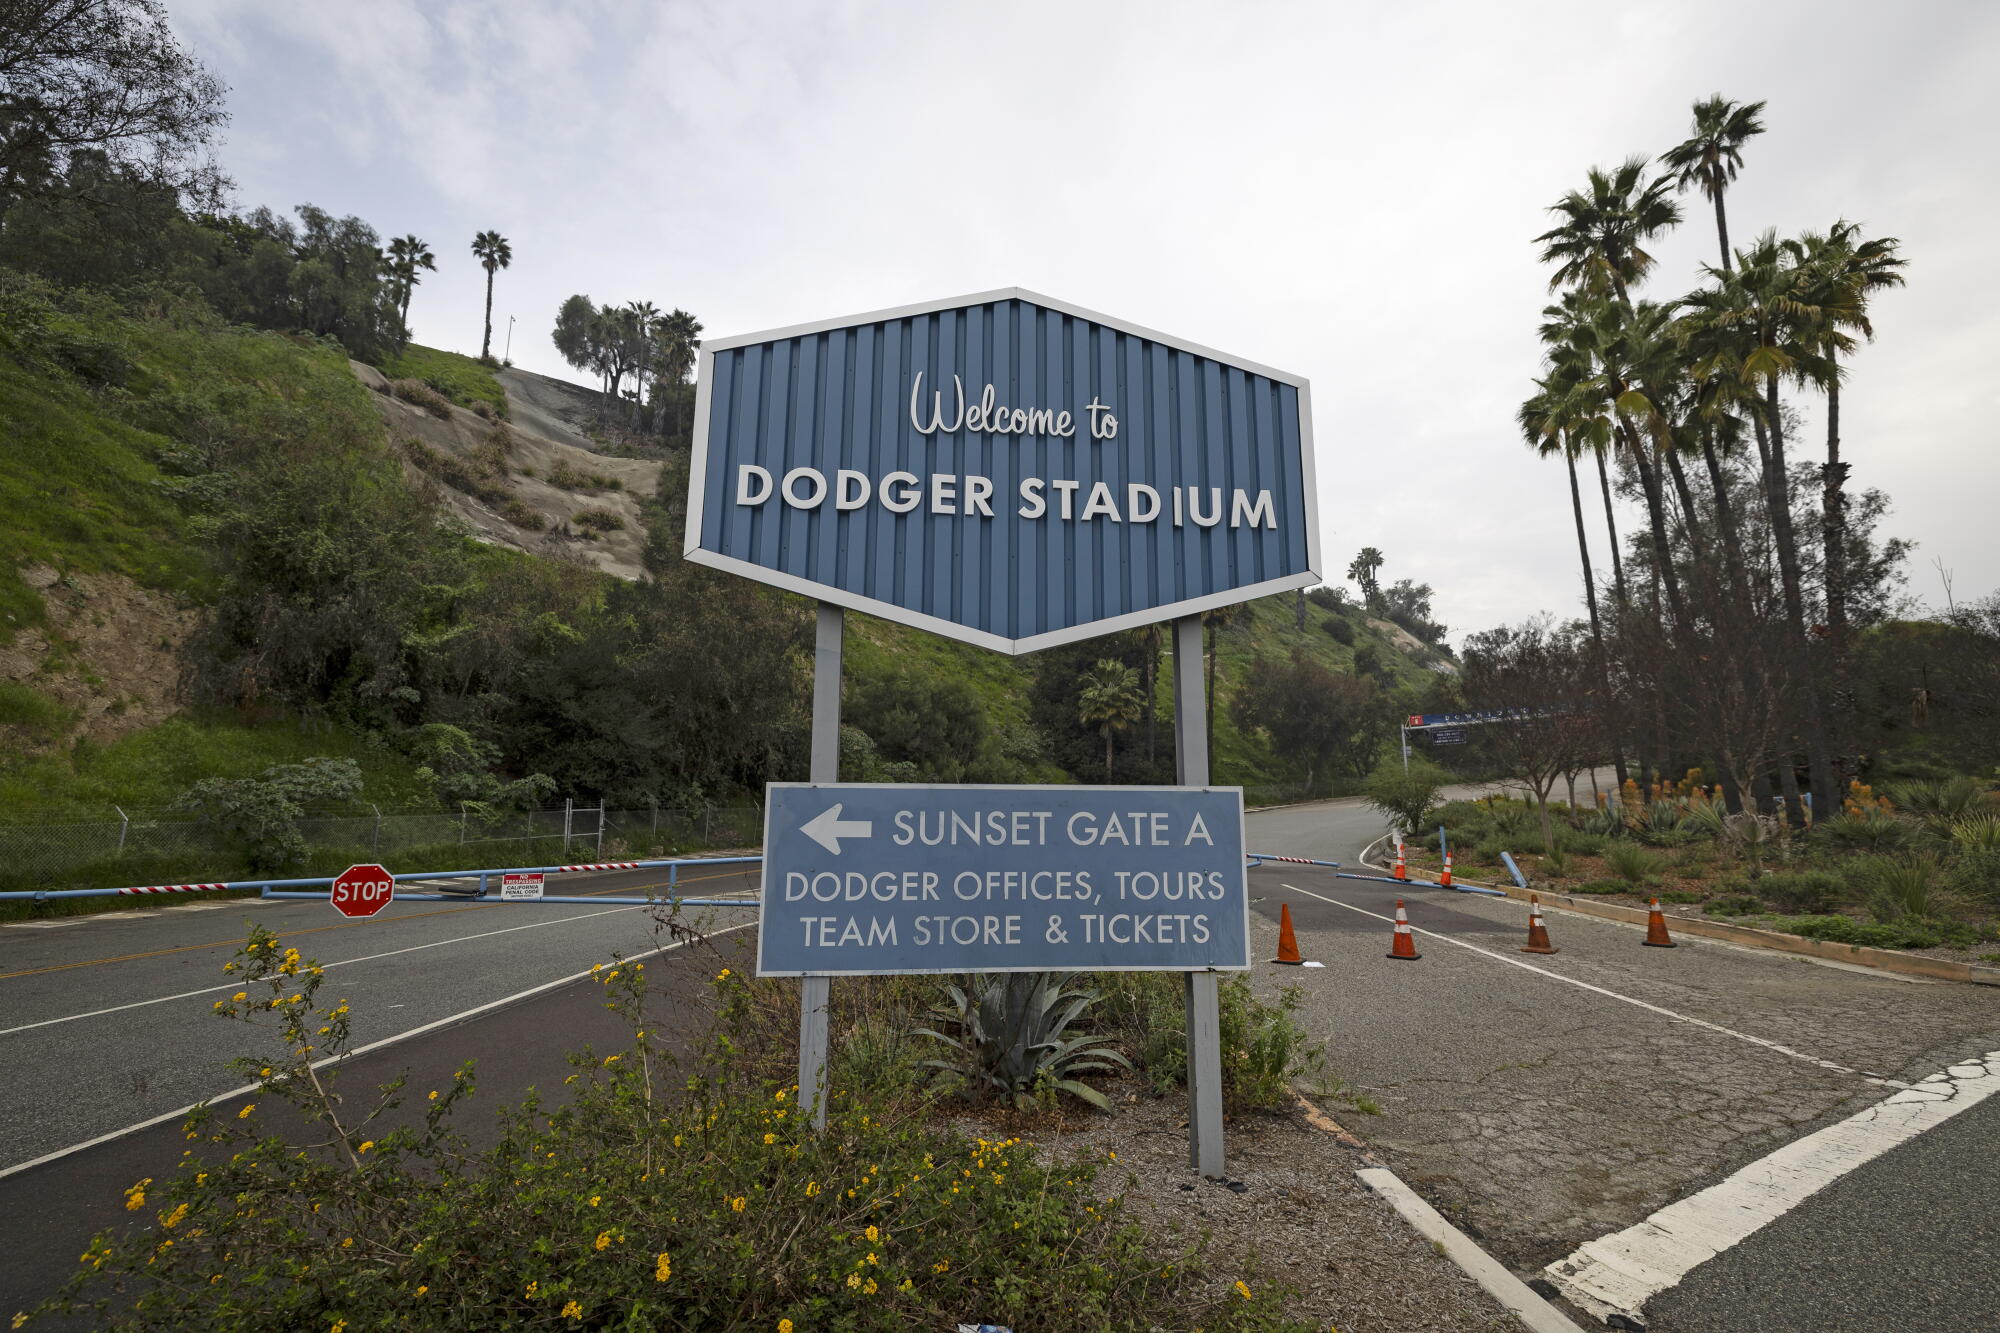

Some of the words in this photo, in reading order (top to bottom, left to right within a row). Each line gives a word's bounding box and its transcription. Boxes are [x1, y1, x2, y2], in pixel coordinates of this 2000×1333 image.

[910, 371, 1076, 437] Welcome
[1085, 396, 1119, 439] to
[736, 464, 995, 517] DODGER
[1018, 477, 1277, 529] STADIUM
[892, 810, 1052, 846] SUNSET
[1066, 811, 1170, 846] GATE
[1184, 812, 1214, 846] A
[336, 881, 389, 902] STOP
[785, 871, 940, 902] DODGER
[953, 871, 1102, 906] OFFICES,
[1114, 871, 1225, 901] TOURS
[799, 915, 898, 948] TEAM
[913, 915, 1021, 946] STORE
[1045, 914, 1069, 944] &
[1079, 913, 1210, 944] TICKETS
